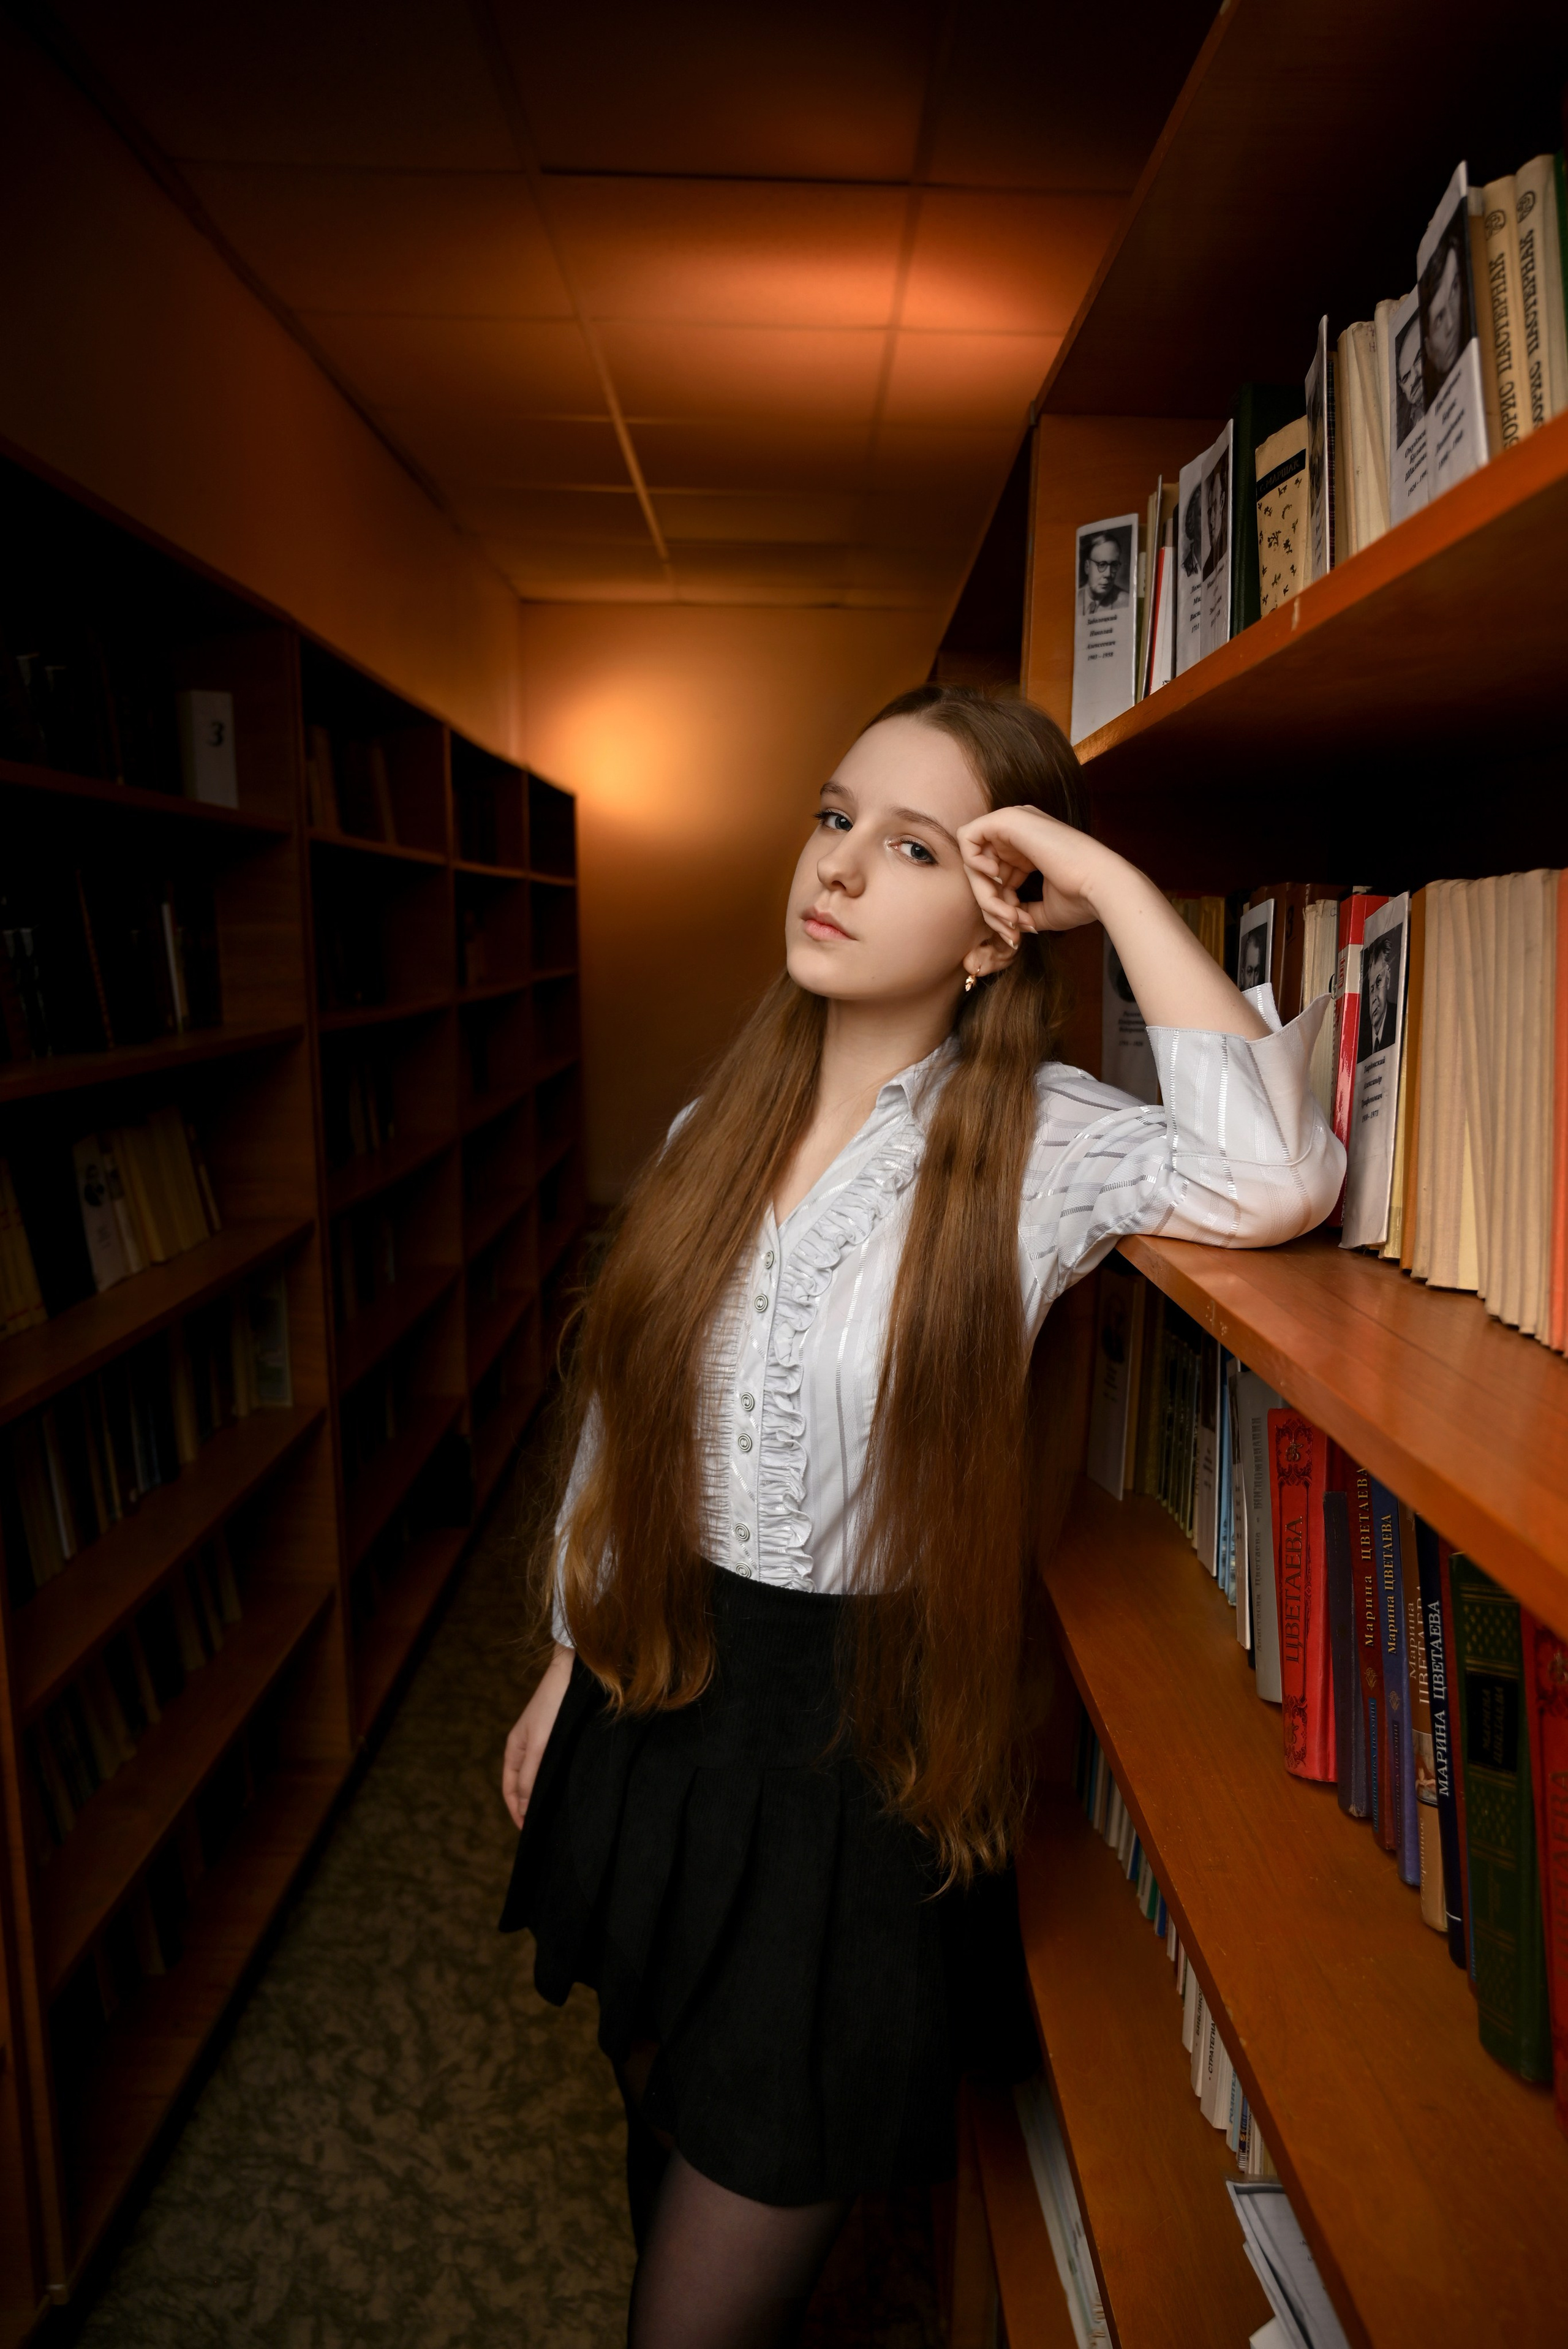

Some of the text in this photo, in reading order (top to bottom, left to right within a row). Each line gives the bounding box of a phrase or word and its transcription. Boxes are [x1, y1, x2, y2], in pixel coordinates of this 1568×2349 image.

[1489, 252, 1512, 378] ПАСТЕРНАК
[1520, 228, 1544, 429] ОРИС ПАСТЕРНАК
[206, 721, 224, 747] 3
[1284, 1516, 1303, 1664] ЦВЕТАЕВА
[1356, 1468, 1376, 1647] Марина ЦВЕТАЕВА
[1381, 1514, 1399, 1654] Марина ЦВЕТАЕВА
[1408, 1602, 1418, 1679] Марина
[1416, 1586, 1430, 1703] ЦВЕТАЕВ
[1427, 1600, 1450, 1798] МАРИНА ЦВЕТАЕВА
